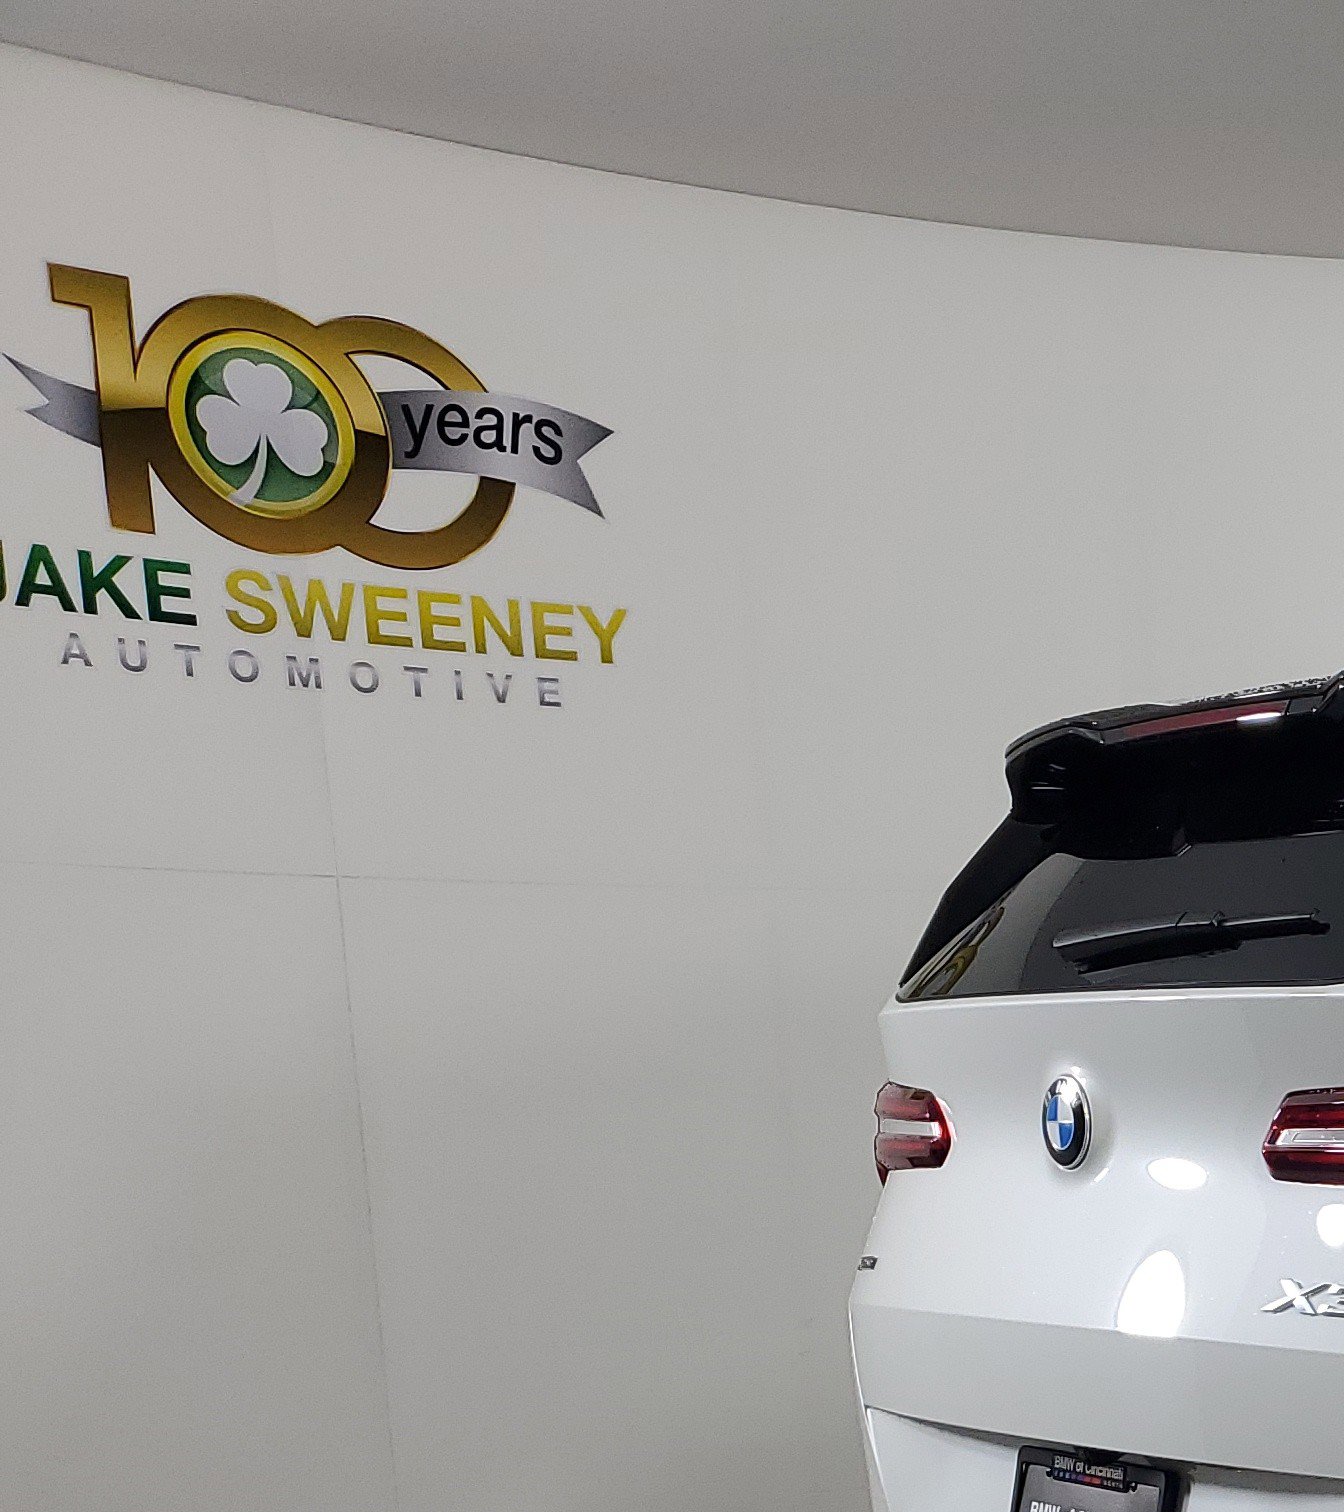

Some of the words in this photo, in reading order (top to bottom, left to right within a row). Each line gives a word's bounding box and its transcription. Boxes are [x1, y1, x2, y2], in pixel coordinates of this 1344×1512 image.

[401, 402, 565, 465] years
[0, 540, 198, 626] AKE
[225, 569, 627, 664] SWEENEY
[60, 632, 562, 708] AUTOMOTIVE
